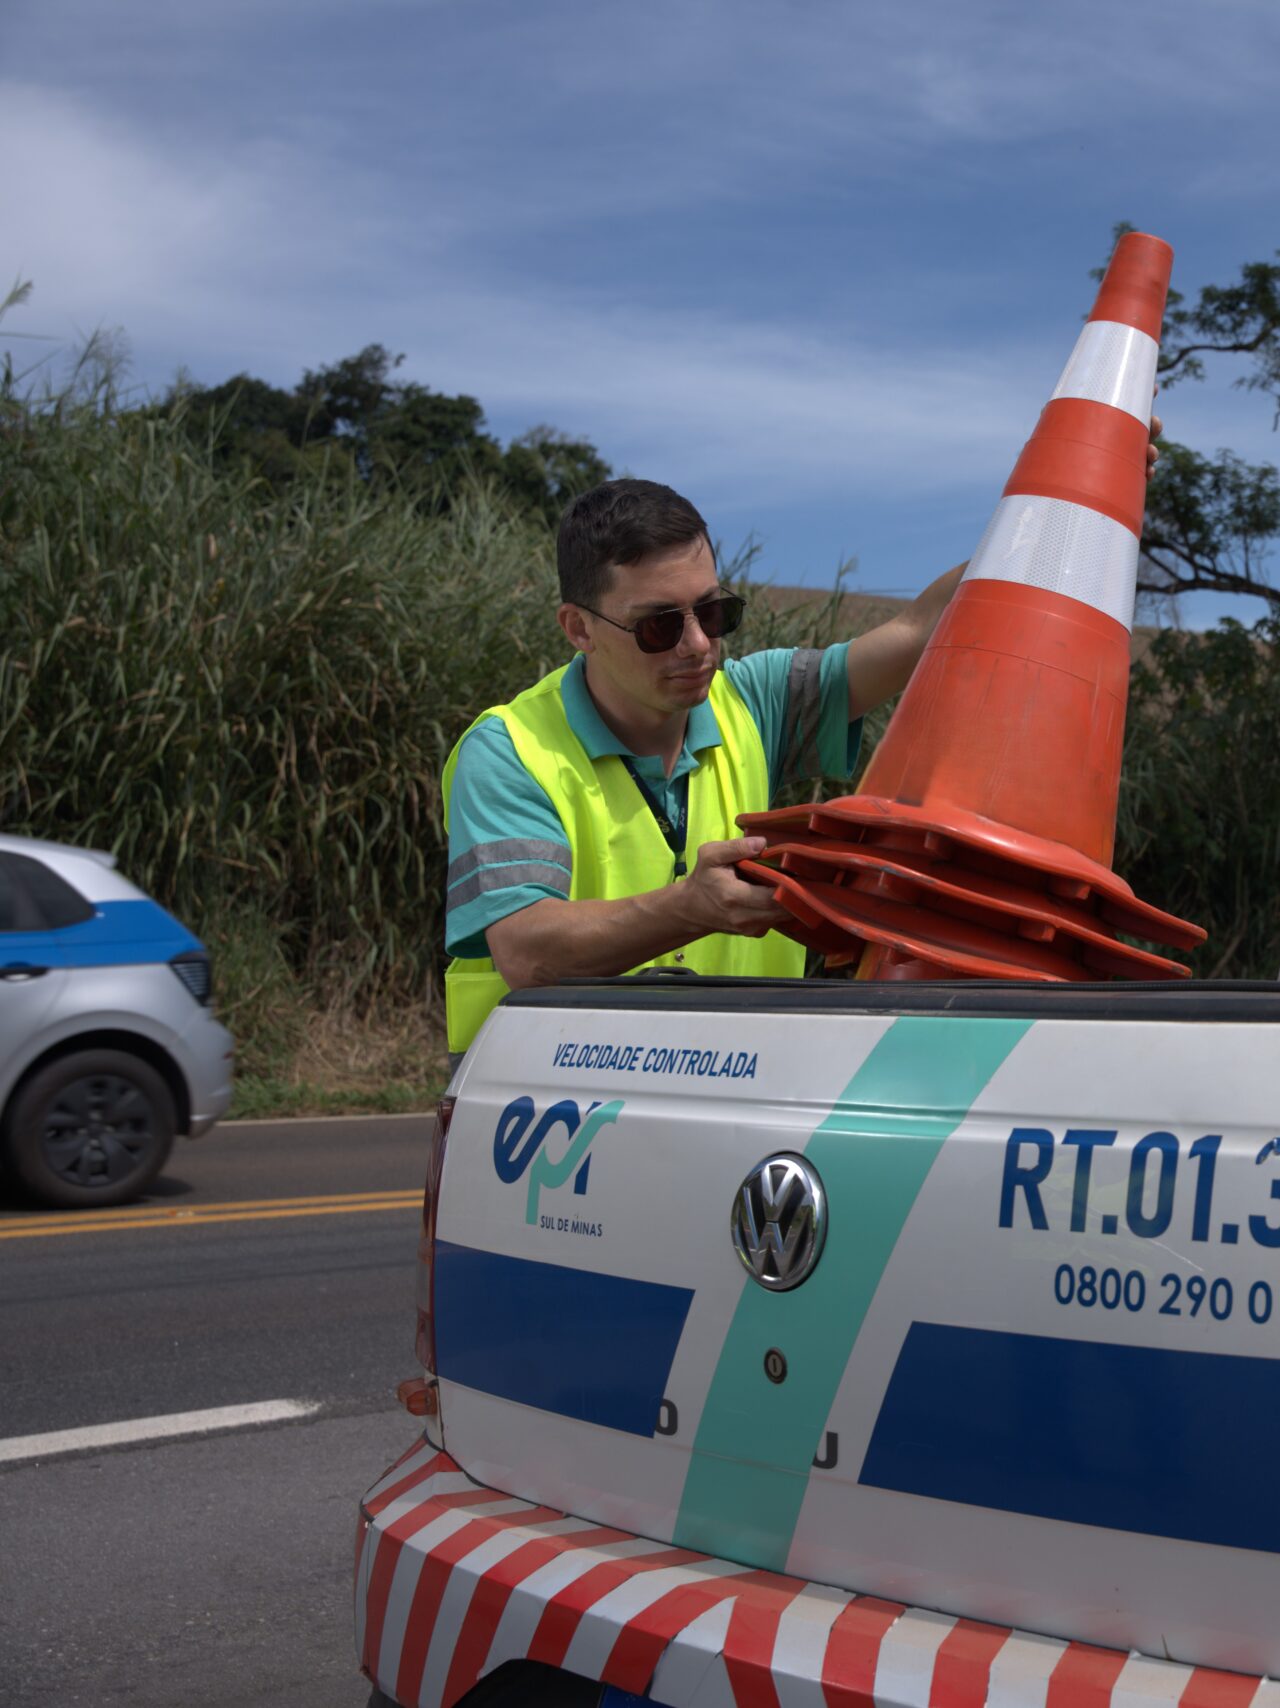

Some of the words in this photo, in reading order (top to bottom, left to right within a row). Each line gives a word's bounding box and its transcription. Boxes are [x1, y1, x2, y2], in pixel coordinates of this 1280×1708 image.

[552, 1043, 644, 1071] VELOCIDADE
[642, 1047, 758, 1079] CONTROLADA
[540, 1215, 555, 1230] SUL
[557, 1218, 569, 1232] DE
[571, 1220, 603, 1237] MINAS
[1054, 1263, 1146, 1312] 0800
[1158, 1272, 1233, 1321] 290
[1248, 1280, 1273, 1324] 0
